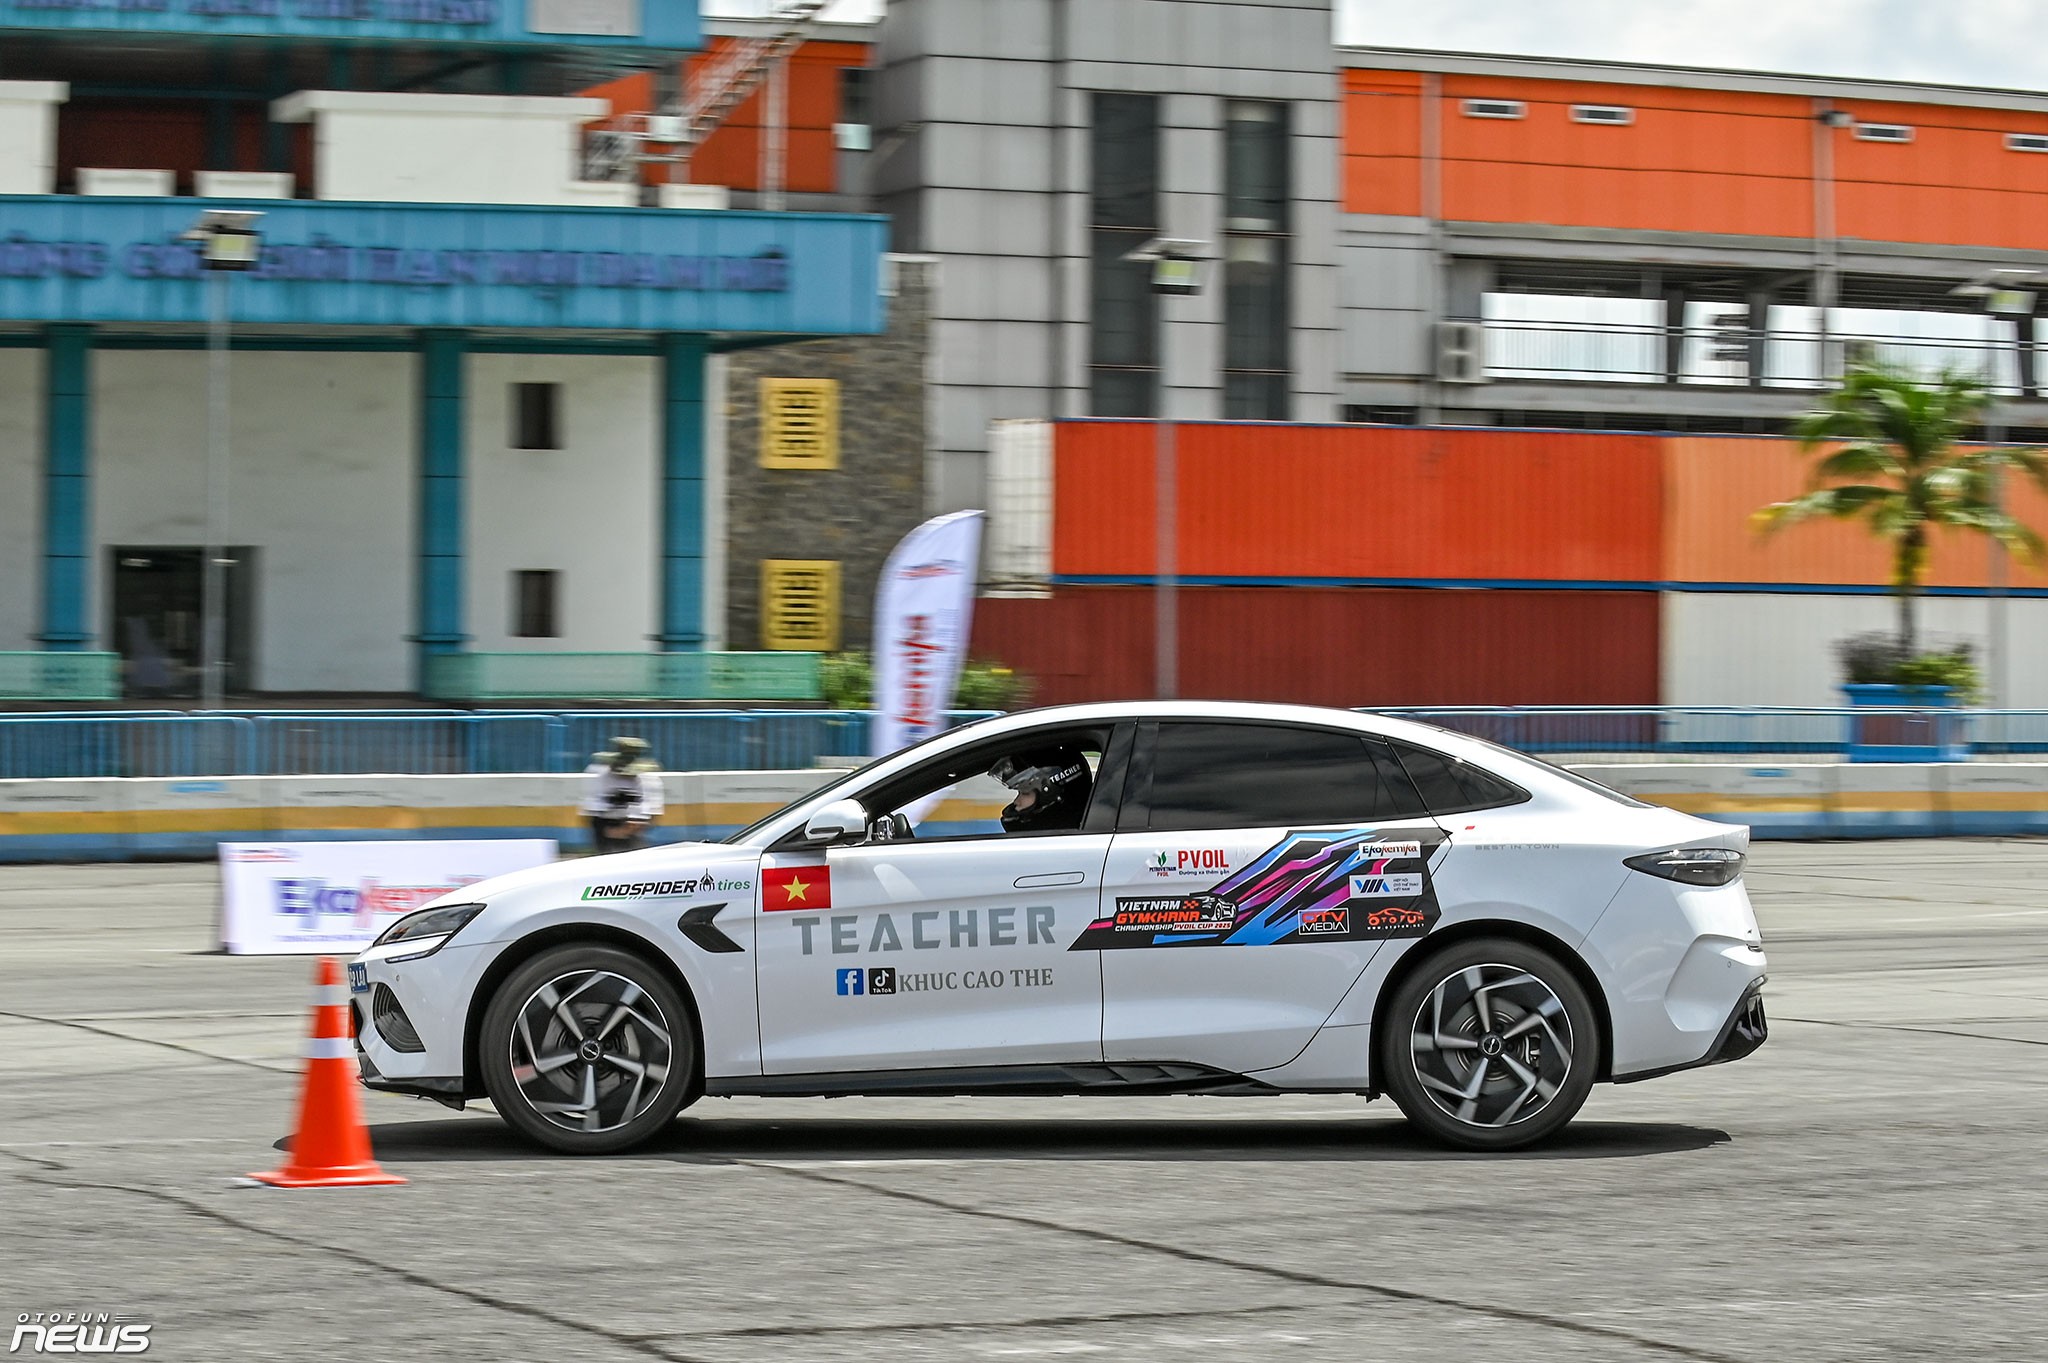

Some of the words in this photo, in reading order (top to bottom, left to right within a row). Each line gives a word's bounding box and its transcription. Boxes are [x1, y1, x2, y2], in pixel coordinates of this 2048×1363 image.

[1049, 763, 1081, 783] TEACHER
[1178, 849, 1229, 869] PVOIL
[1362, 844, 1417, 857] Ekokemika
[581, 879, 698, 901] LANDSPIDER
[718, 879, 751, 891] tires
[1120, 900, 1181, 912] VIETNAM
[1116, 911, 1200, 925] GYMKHANA
[1303, 921, 1347, 932] MEDIA
[792, 905, 1057, 956] TEACHER
[1115, 924, 1173, 932] CHAMPIONSHIP
[899, 972, 957, 992] KHUC
[963, 970, 1004, 989] CAO
[1010, 968, 1054, 987] THE
